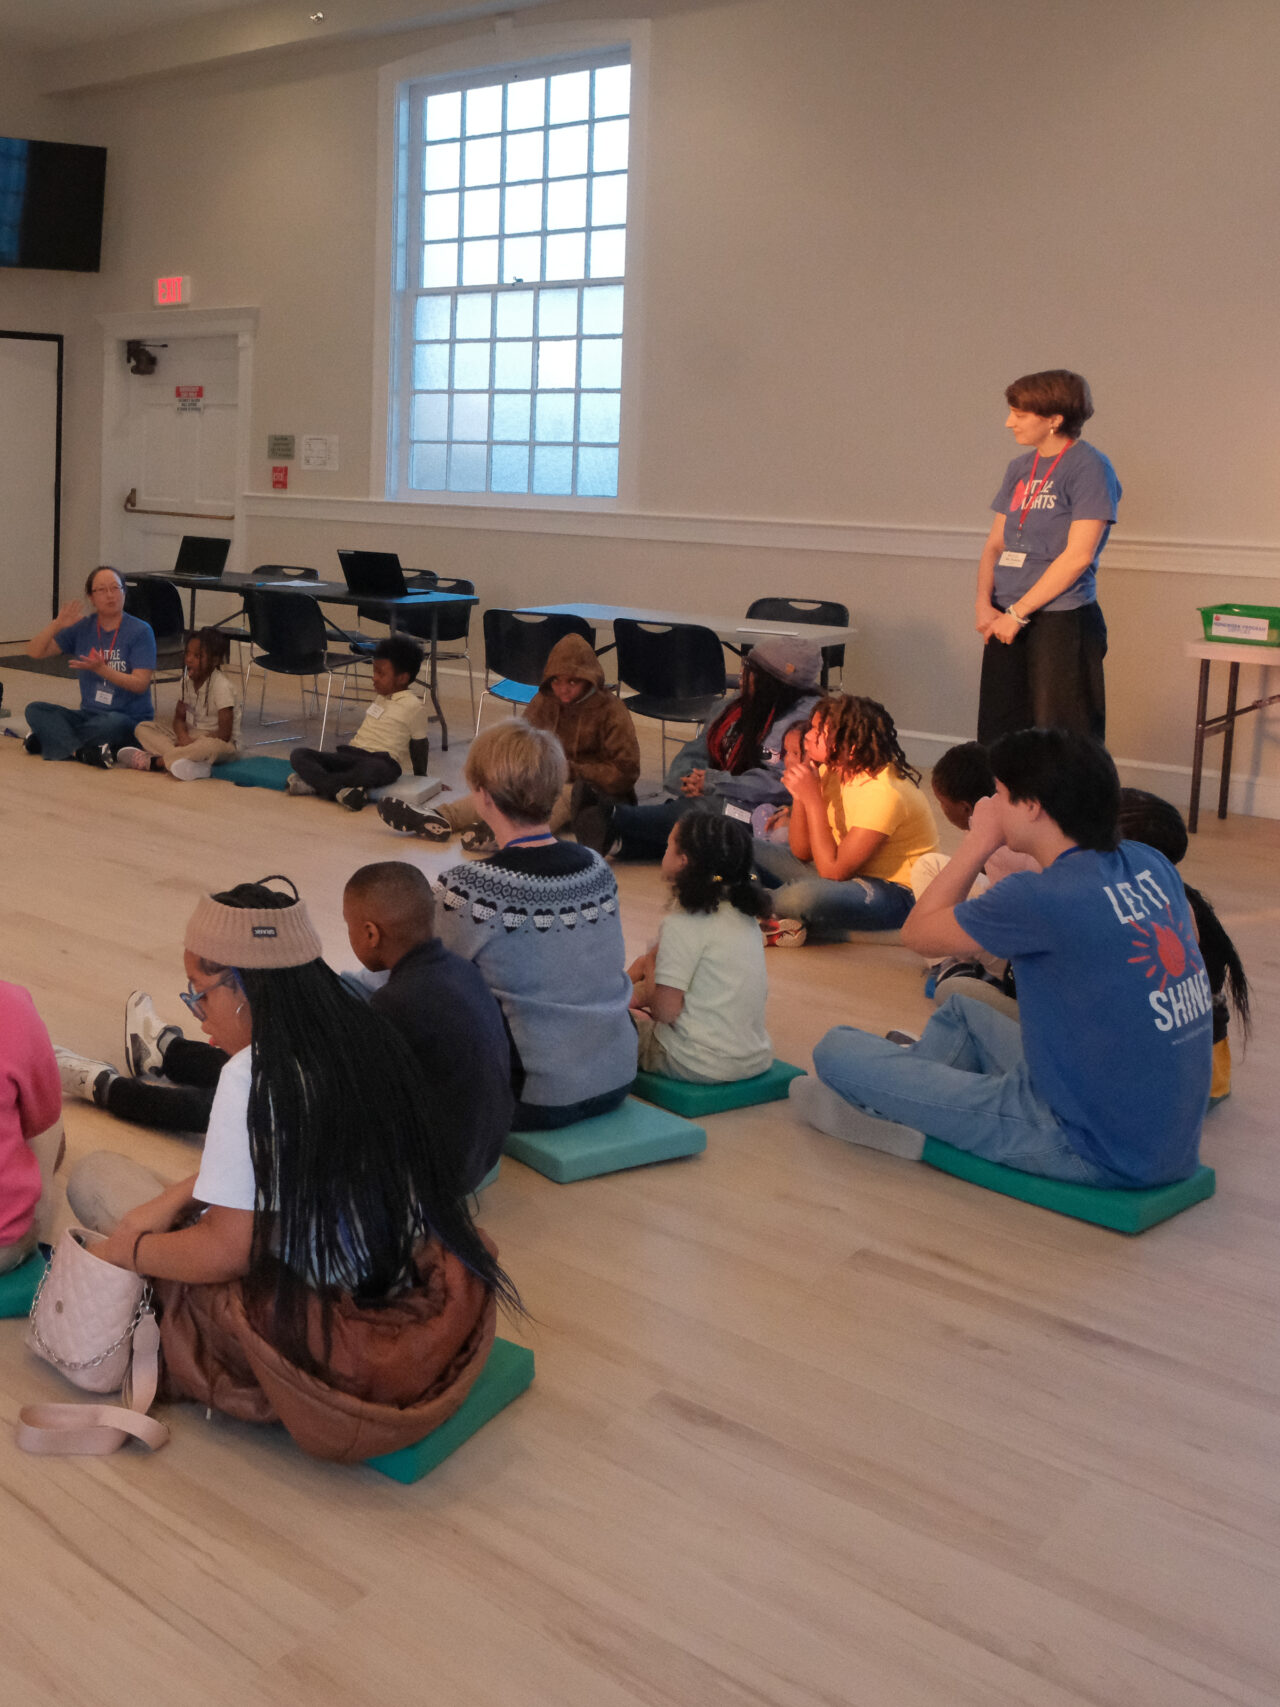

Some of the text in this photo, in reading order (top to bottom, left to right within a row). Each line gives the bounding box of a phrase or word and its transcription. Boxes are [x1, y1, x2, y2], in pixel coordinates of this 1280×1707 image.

[158, 277, 183, 303] EXIT
[1103, 882, 1151, 925] LET
[1148, 969, 1212, 1032] SHINE
